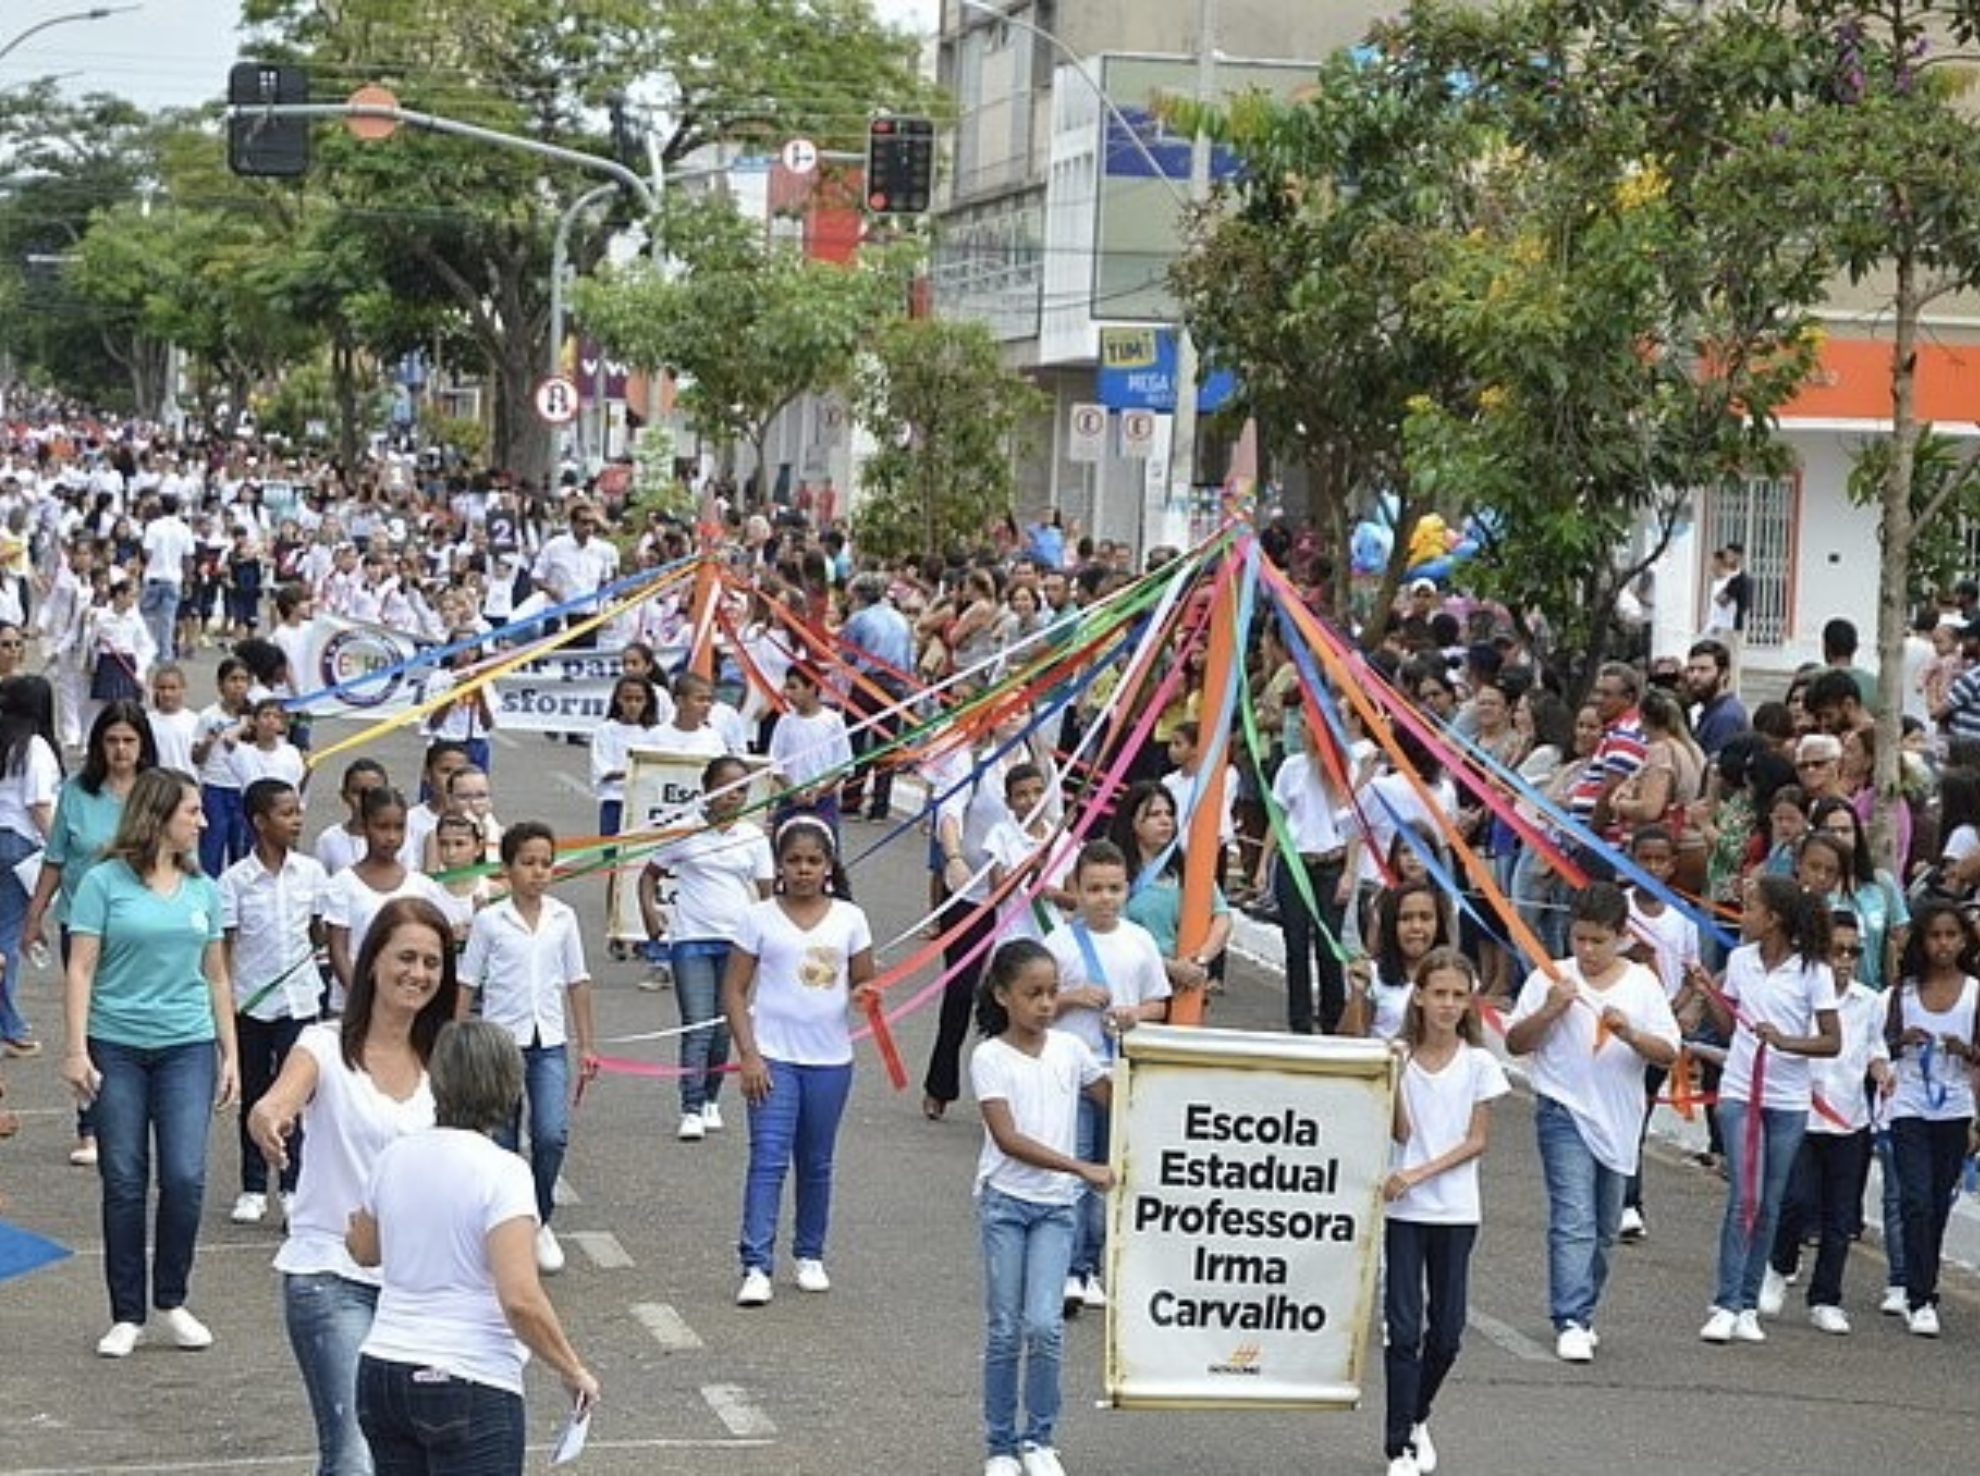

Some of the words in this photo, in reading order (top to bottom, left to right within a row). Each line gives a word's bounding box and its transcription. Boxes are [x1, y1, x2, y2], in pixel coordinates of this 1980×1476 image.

[492, 518, 512, 544] 2
[1185, 1104, 1318, 1146] Escola
[1160, 1150, 1338, 1194] Estadual
[1135, 1195, 1355, 1242] Professora
[1194, 1246, 1288, 1285] Irma
[1150, 1290, 1326, 1332] Carvalho
